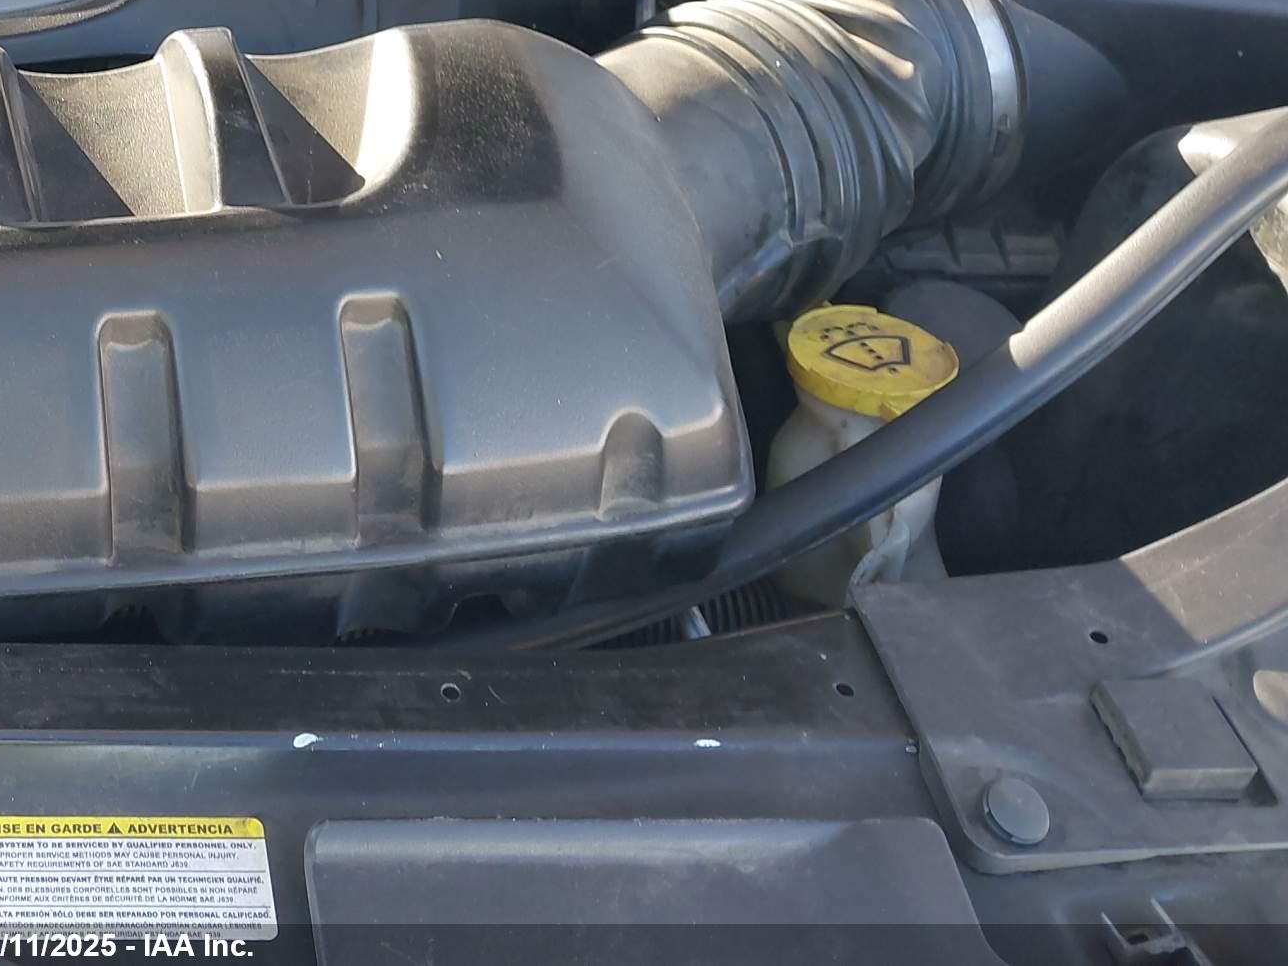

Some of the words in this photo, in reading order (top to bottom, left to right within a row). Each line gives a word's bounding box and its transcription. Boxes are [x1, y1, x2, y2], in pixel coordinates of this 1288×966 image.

[26, 823, 46, 834] EN
[51, 823, 102, 834] GARDE
[128, 823, 233, 835] ADVERTENCIA
[66, 841, 109, 849] SERVICED
[112, 841, 123, 849] BY
[127, 841, 172, 849] QUALIFIED
[175, 841, 227, 849] PERSONNEL
[36, 851, 70, 859] SERVICE
[73, 851, 112, 859] METHODS
[114, 851, 130, 859] MAY
[133, 851, 160, 859] CAUSE
[163, 851, 206, 859] PERSONAL
[21, 875, 58, 883] PRESSION
[165, 876, 176, 884] UN
[179, 876, 225, 884] TECHNICIEN
[161, 911, 176, 919] POR
[179, 911, 220, 919] PERSONAL
